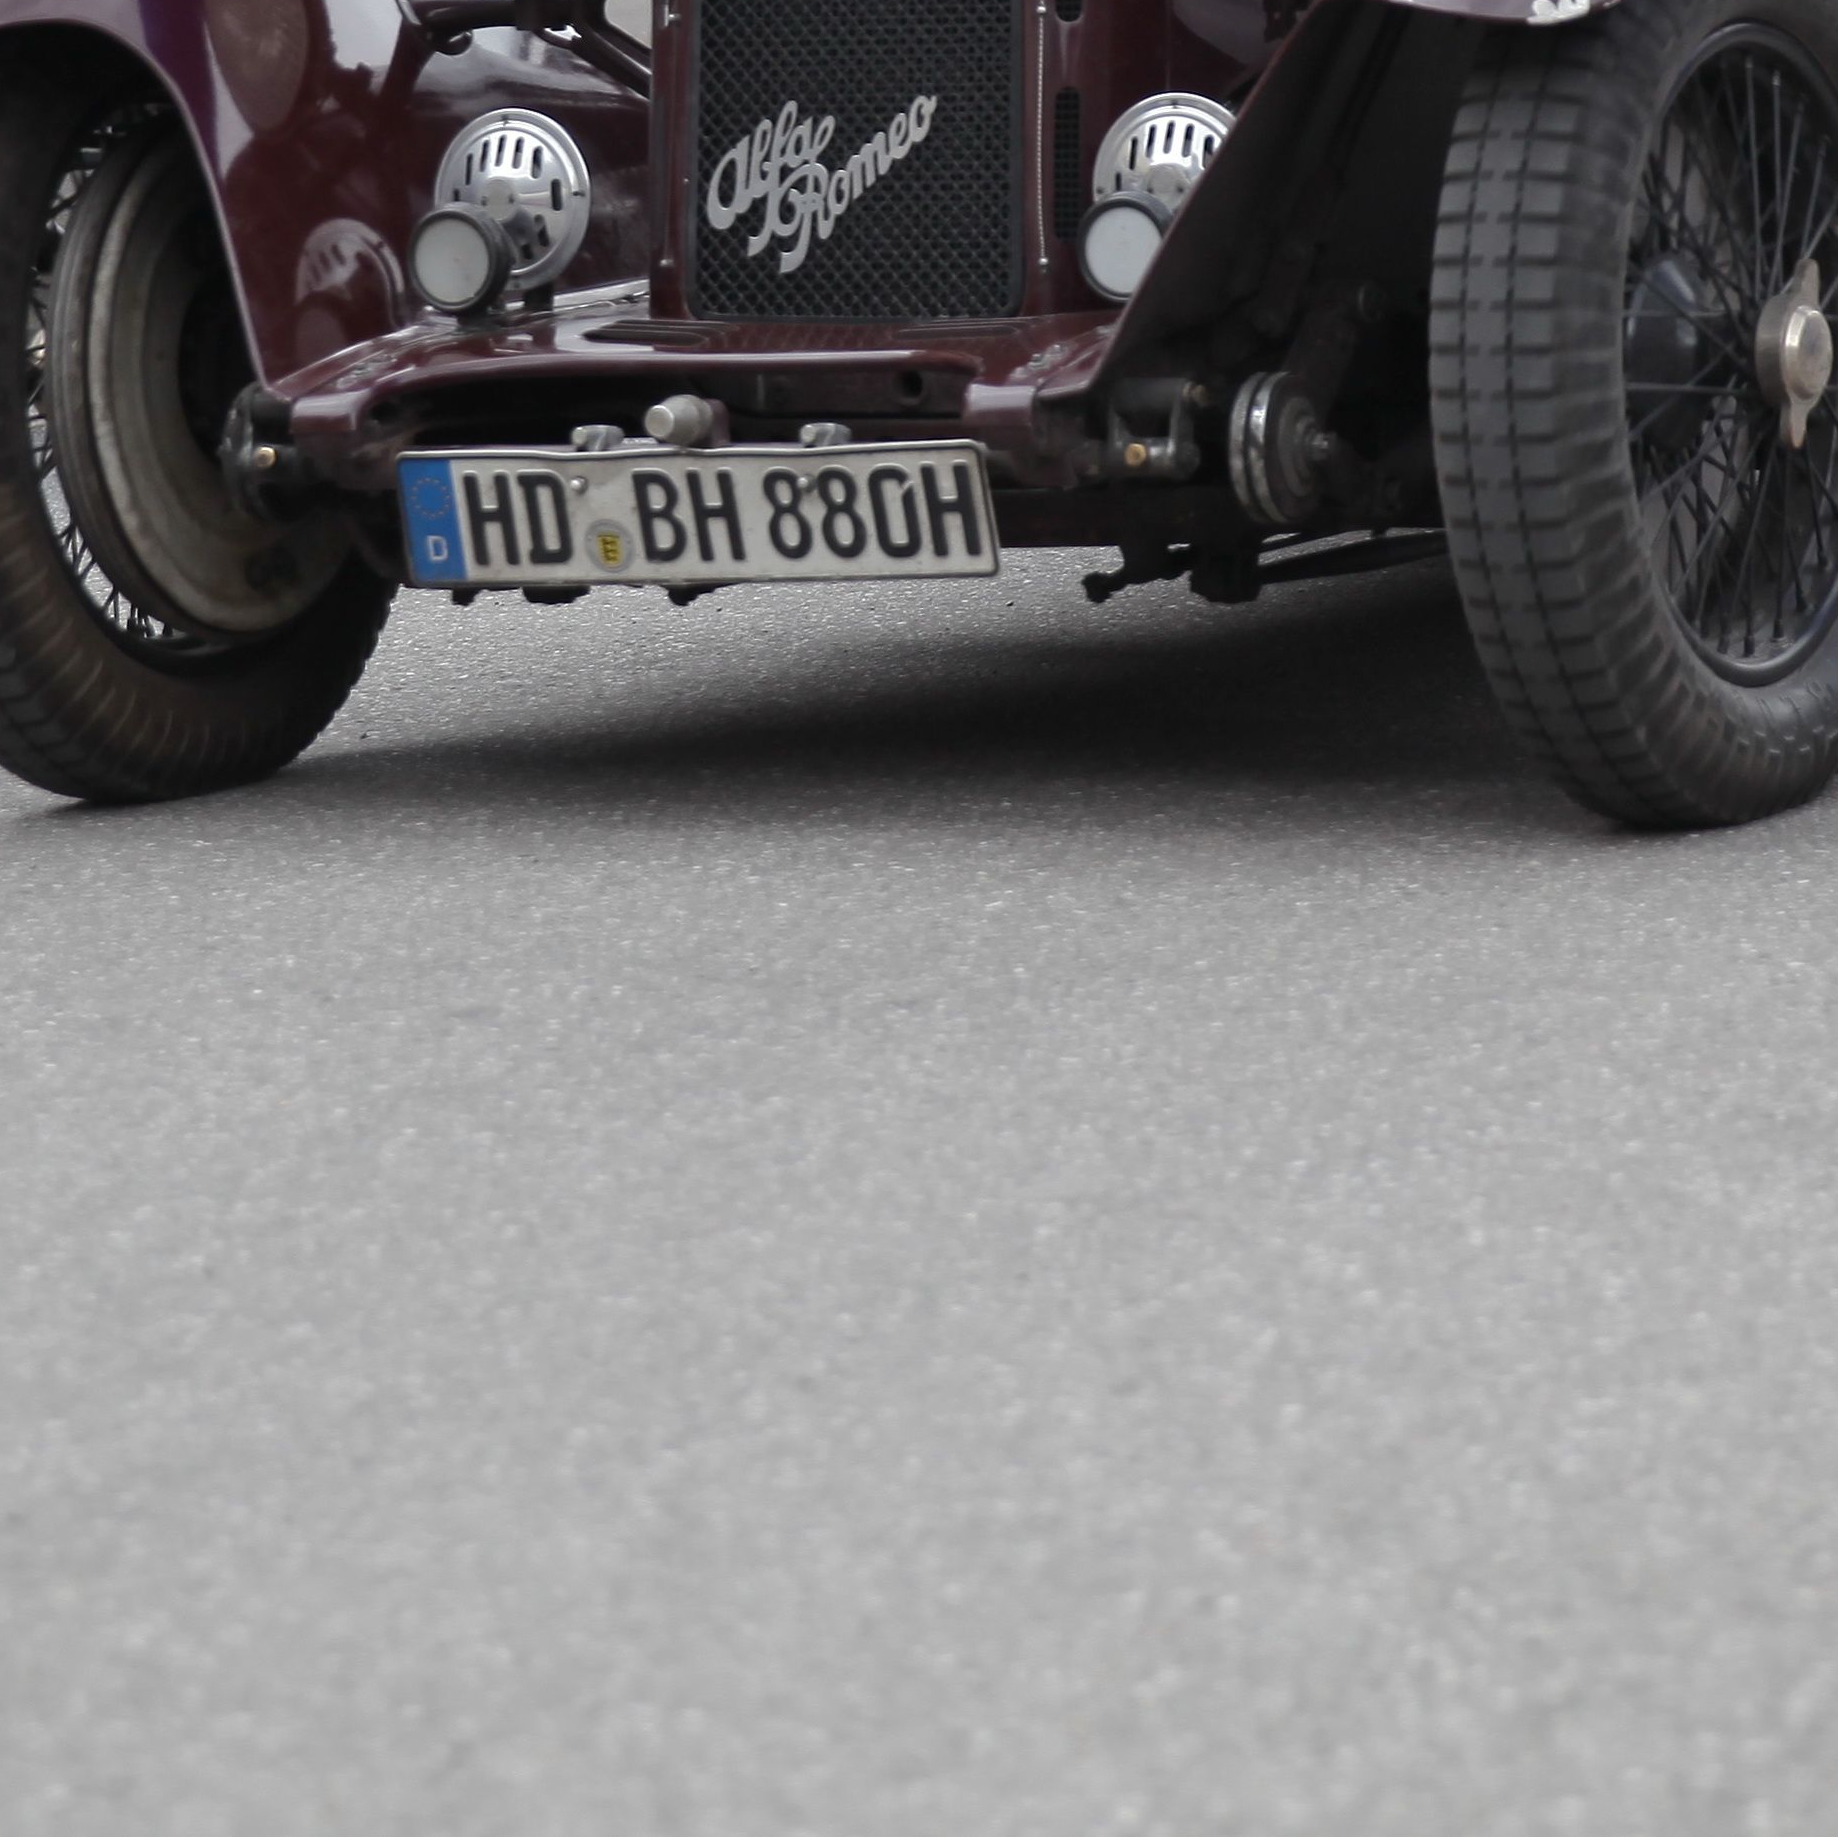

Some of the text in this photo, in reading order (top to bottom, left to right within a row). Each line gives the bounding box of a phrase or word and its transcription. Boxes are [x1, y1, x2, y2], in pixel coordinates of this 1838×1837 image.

[707, 100, 836, 257] Alfa
[774, 95, 938, 274] Romeo
[427, 534, 449, 562] D
[463, 459, 982, 566] HD BH 880H
